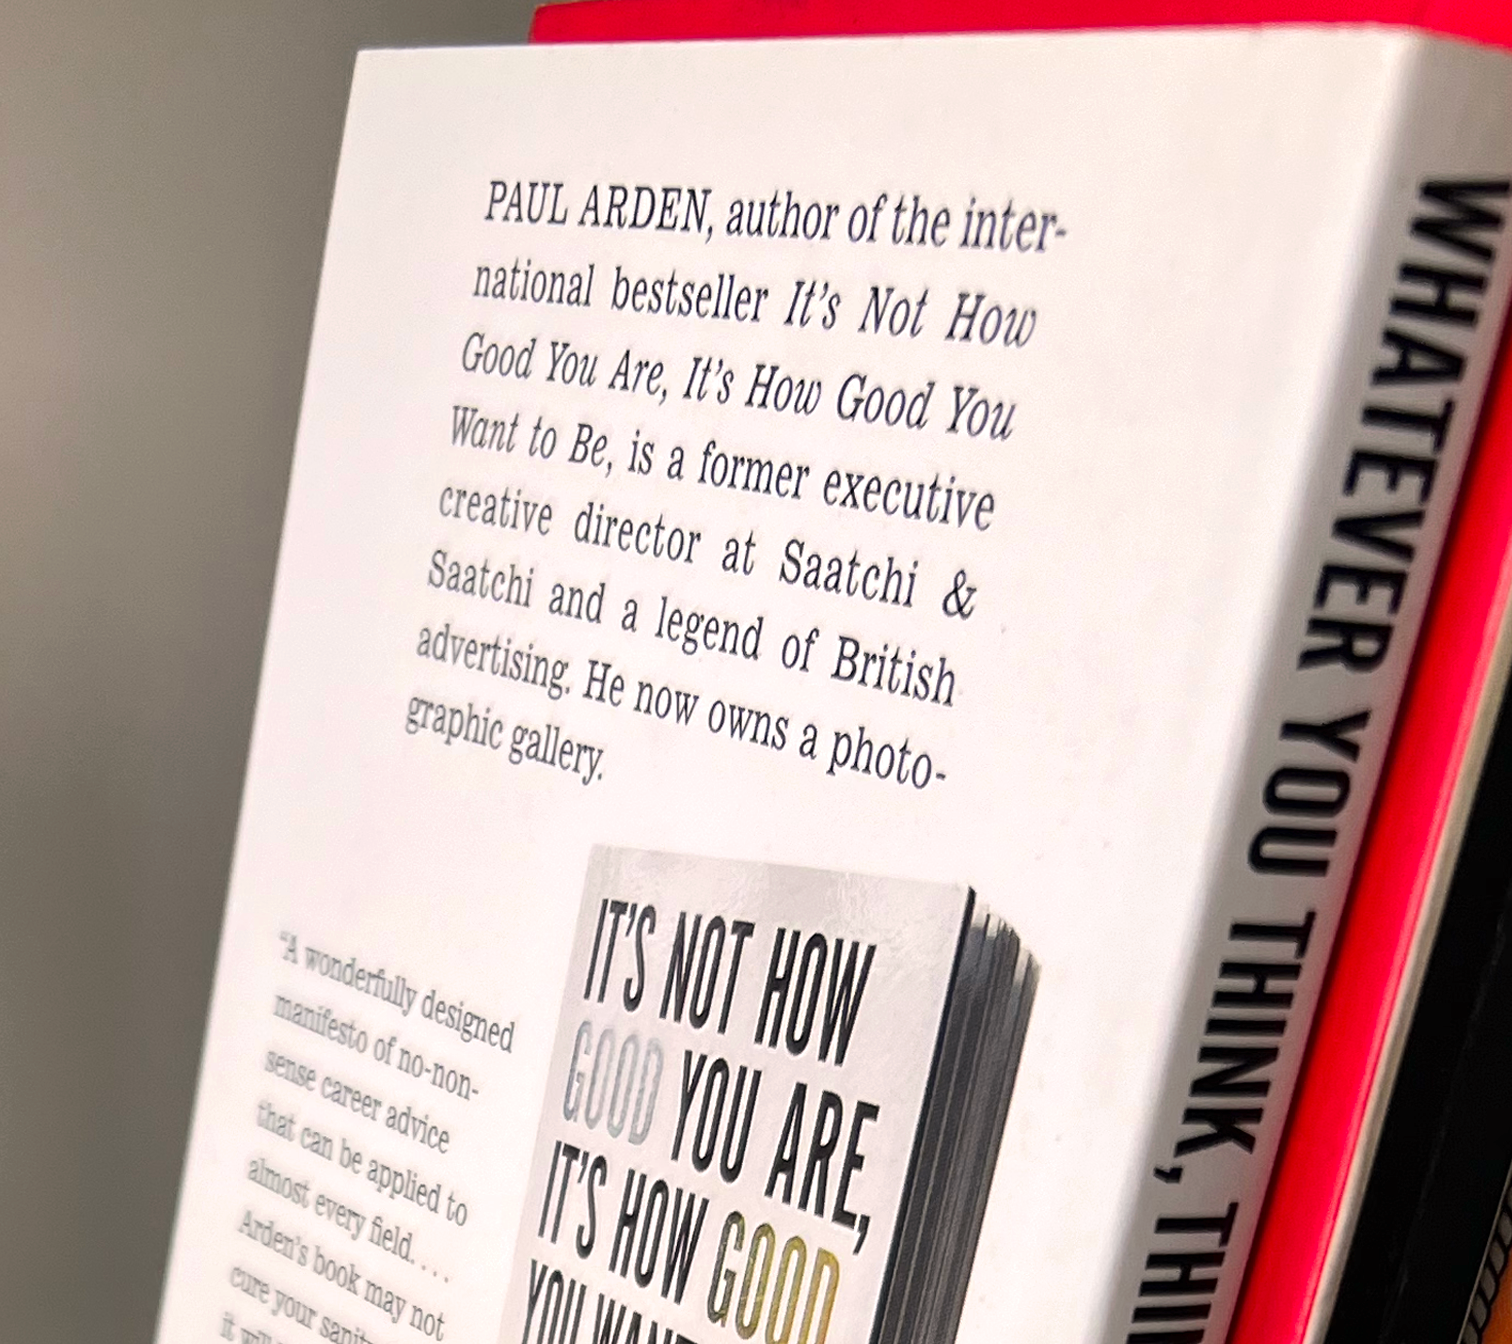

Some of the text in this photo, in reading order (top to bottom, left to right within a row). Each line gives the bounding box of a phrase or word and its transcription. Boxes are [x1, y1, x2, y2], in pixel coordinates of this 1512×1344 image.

[485, 180, 1067, 253] PAUL ARDEN, author of the inter-
[473, 257, 1037, 348] national bestseller It's Not How
[463, 332, 1017, 441] Good You Are, It's How Good You
[1296, 180, 1510, 672] WHATEVER
[452, 405, 994, 531] Want to Be, is a former executive
[440, 487, 977, 620] creative director at Saatchi &
[428, 549, 954, 706] Saatchi and a legend of British
[406, 697, 603, 785] graphic gallery.
[417, 624, 945, 789] advertising. He now owns a photo-
[1247, 707, 1371, 879] YOU
[306, 947, 418, 1016] wonderfully
[422, 990, 514, 1053] designed
[583, 897, 876, 1066] IT'S NOT HOW
[265, 1051, 449, 1153] sense career advice
[274, 996, 478, 1100] manifesto of no-non-
[1154, 907, 1316, 1184] THINK,
[258, 1101, 467, 1225] that can be applied to
[563, 1020, 880, 1255] GOOD YOU ARE,
[248, 1158, 310, 1207] almost
[315, 1195, 366, 1240] every
[538, 1140, 607, 1259] IT'S
[609, 1170, 709, 1305] HOW
[221, 1312, 235, 1340] it
[230, 1267, 269, 1303] cure
[272, 1290, 317, 1329] your
[314, 1246, 361, 1295] book
[365, 1280, 407, 1323] may
[410, 1306, 444, 1341] not
